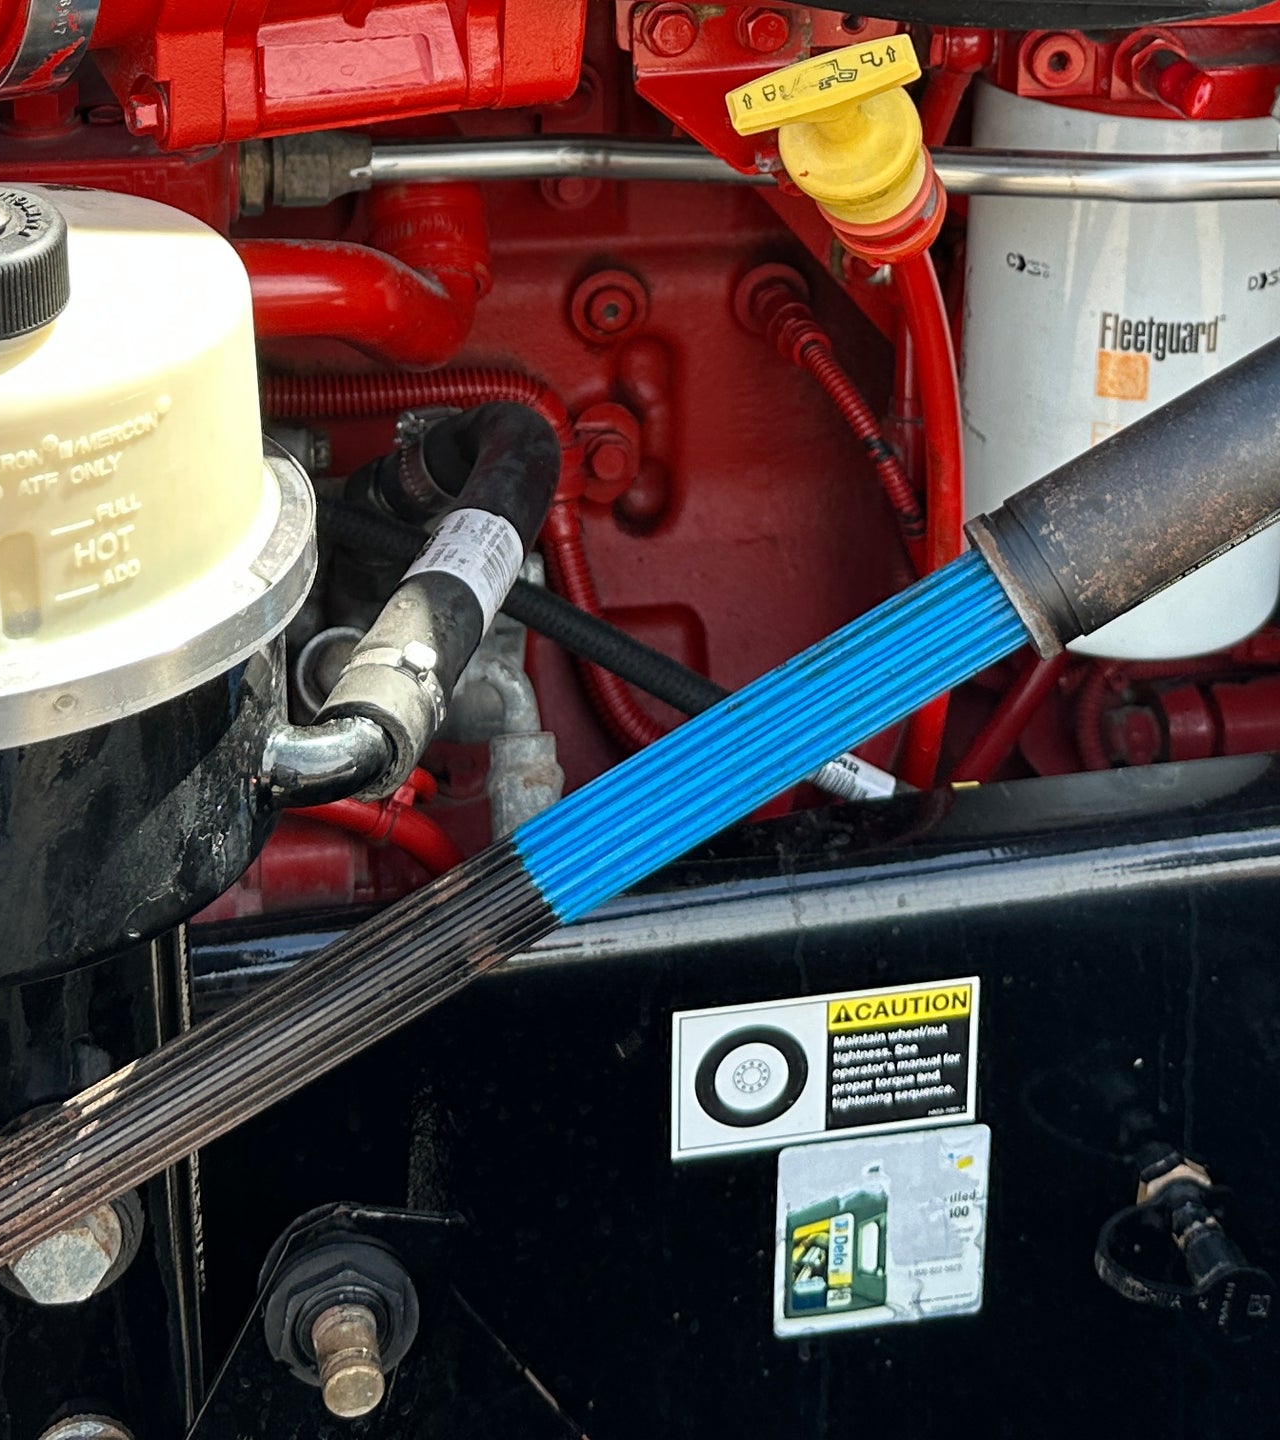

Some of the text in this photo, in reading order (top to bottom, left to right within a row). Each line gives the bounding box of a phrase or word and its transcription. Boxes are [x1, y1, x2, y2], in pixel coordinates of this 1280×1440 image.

[1100, 311, 1219, 362] Fleetguard
[17, 470, 60, 498] ATF
[70, 450, 124, 485] ONLY
[95, 492, 143, 523] FULL
[73, 523, 136, 569] HOT
[103, 557, 142, 588] ADD
[854, 989, 969, 1023] CAUTION
[832, 1031, 887, 1049] Maintain
[832, 1042, 919, 1065] tightness. See
[831, 1051, 962, 1082] operator's manual for
[831, 1068, 942, 1096] proper torque and
[831, 1084, 957, 1112] tightening sequence.
[831, 1233, 848, 1266] Delo
